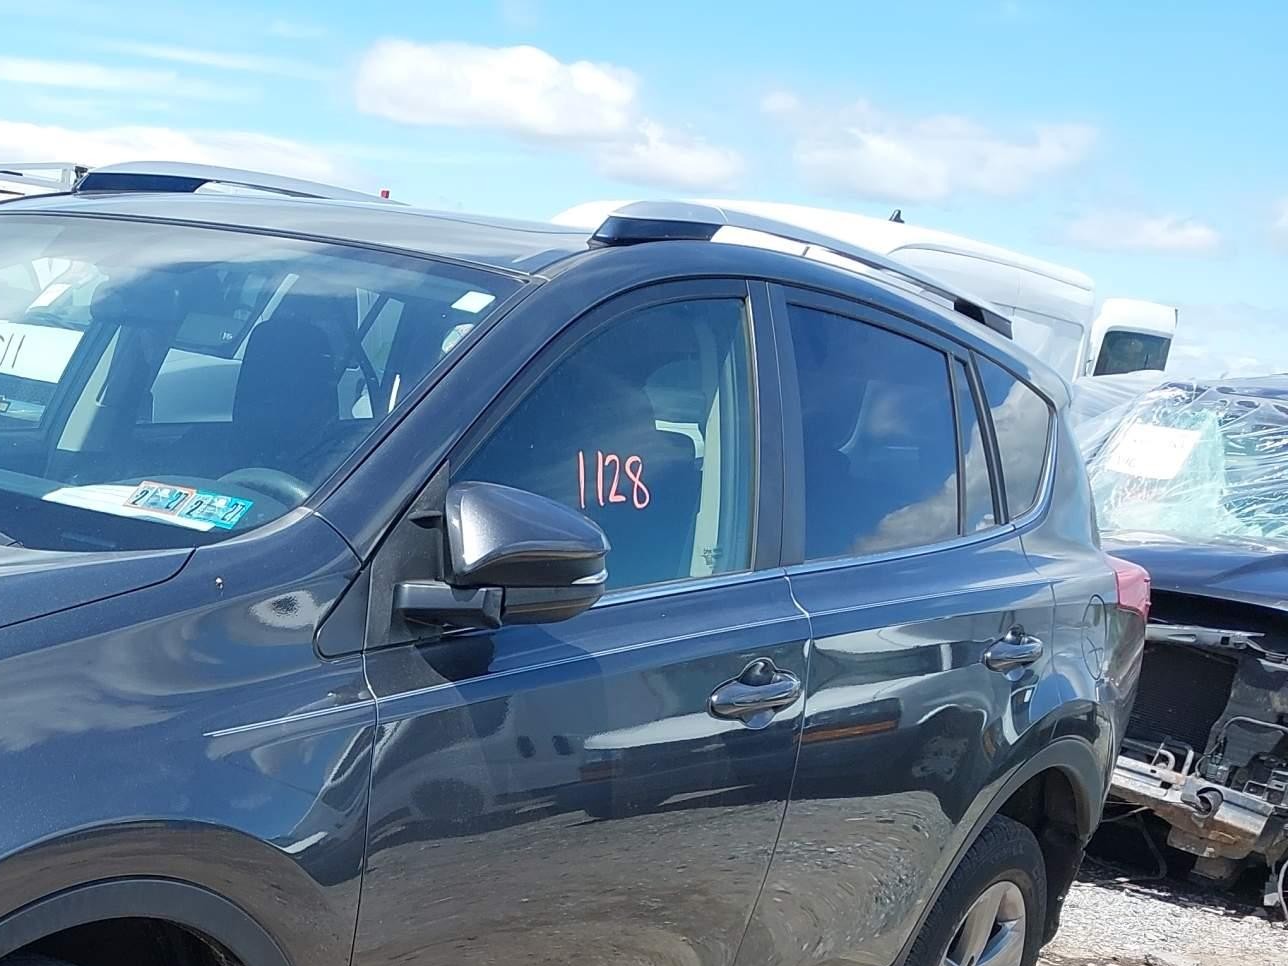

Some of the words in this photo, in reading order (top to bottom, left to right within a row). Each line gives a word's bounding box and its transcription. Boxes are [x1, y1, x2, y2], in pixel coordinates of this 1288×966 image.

[578, 450, 650, 510] 1128
[130, 489, 150, 506] 2
[165, 491, 189, 512] 27
[186, 500, 204, 517] 2
[221, 503, 246, 522] 27
